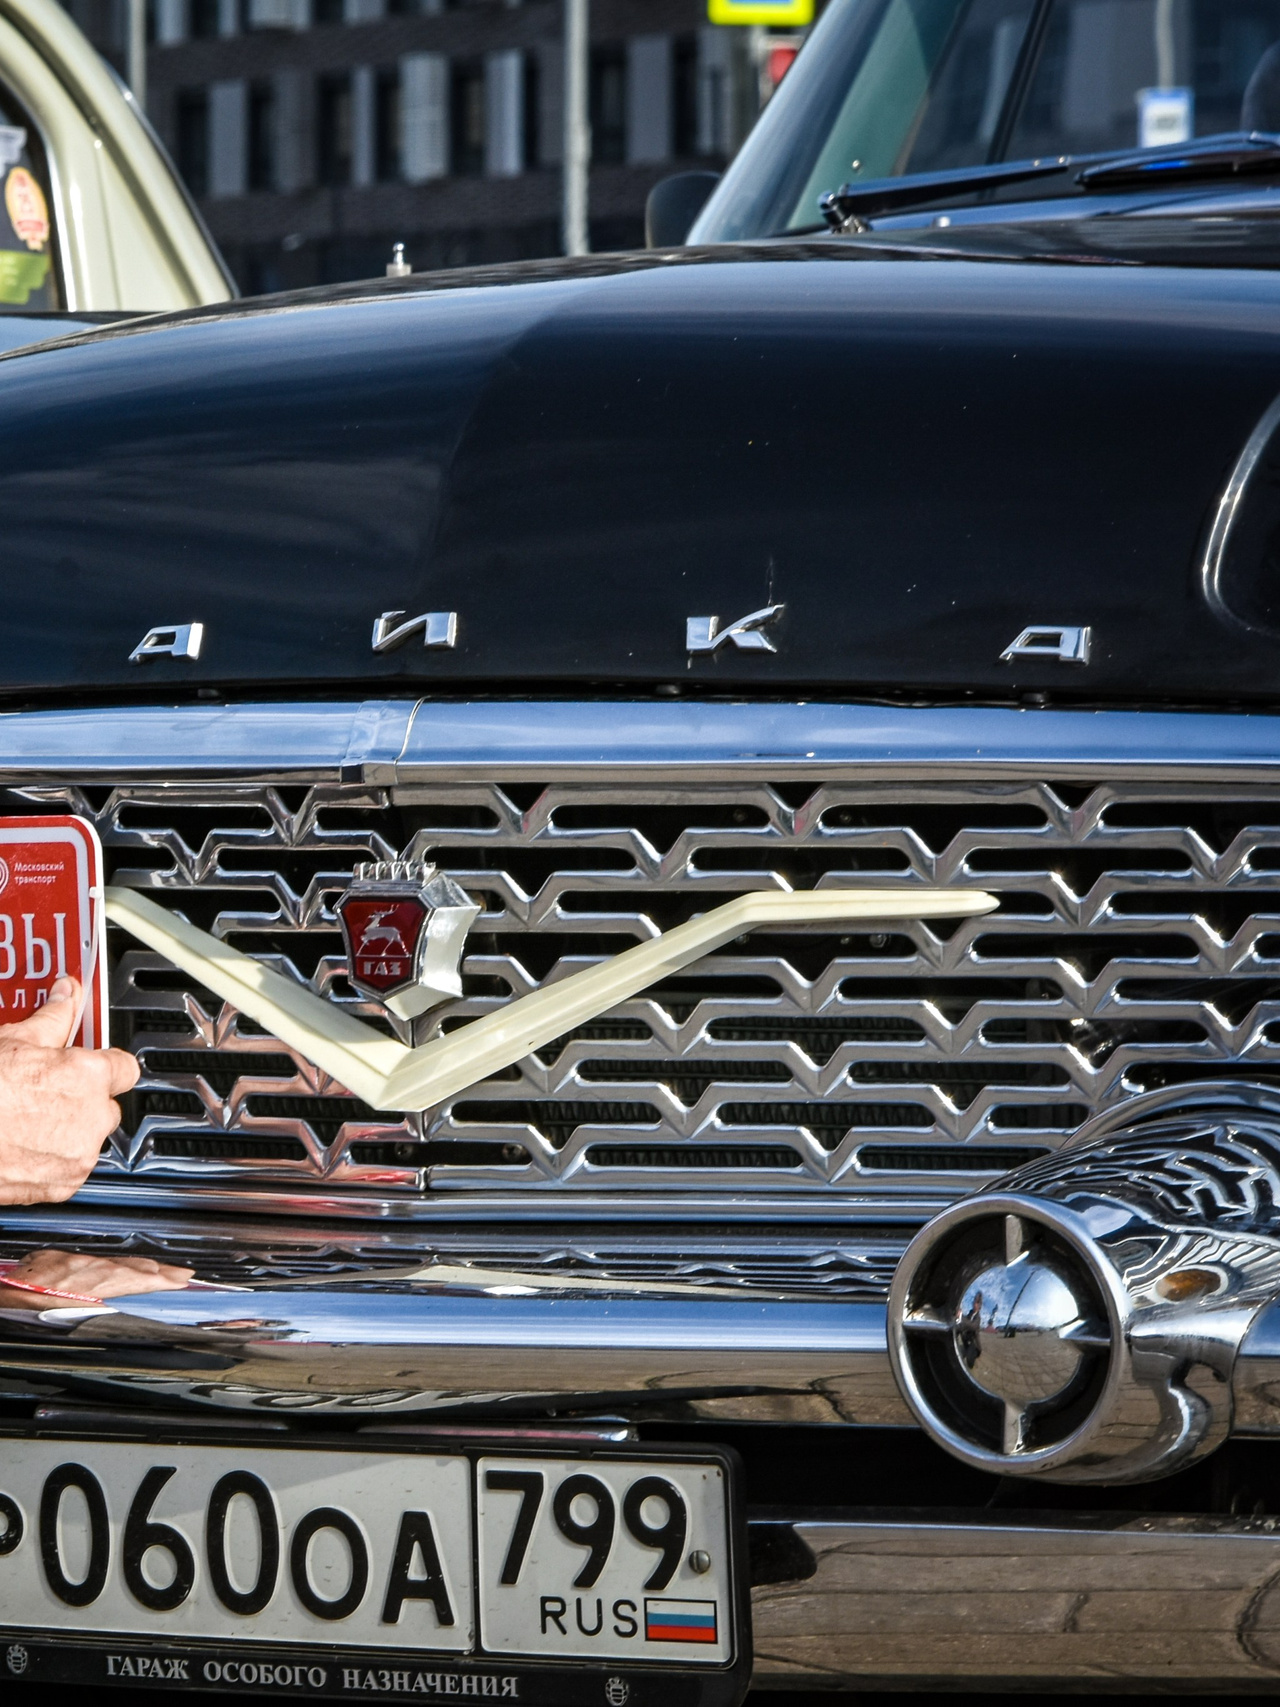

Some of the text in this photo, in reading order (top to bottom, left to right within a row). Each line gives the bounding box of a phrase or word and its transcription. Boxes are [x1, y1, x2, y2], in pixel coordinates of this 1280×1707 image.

[13, 861, 65, 872] Московский
[13, 874, 57, 886] транспорт
[363, 961, 402, 976] ГАЗ
[485, 1469, 688, 1592] 799
[539, 1595, 639, 1639] RUS
[106, 1655, 521, 1698] ГАРАЖ ОСОБОГО НАЗНАЧЕНИЯ
